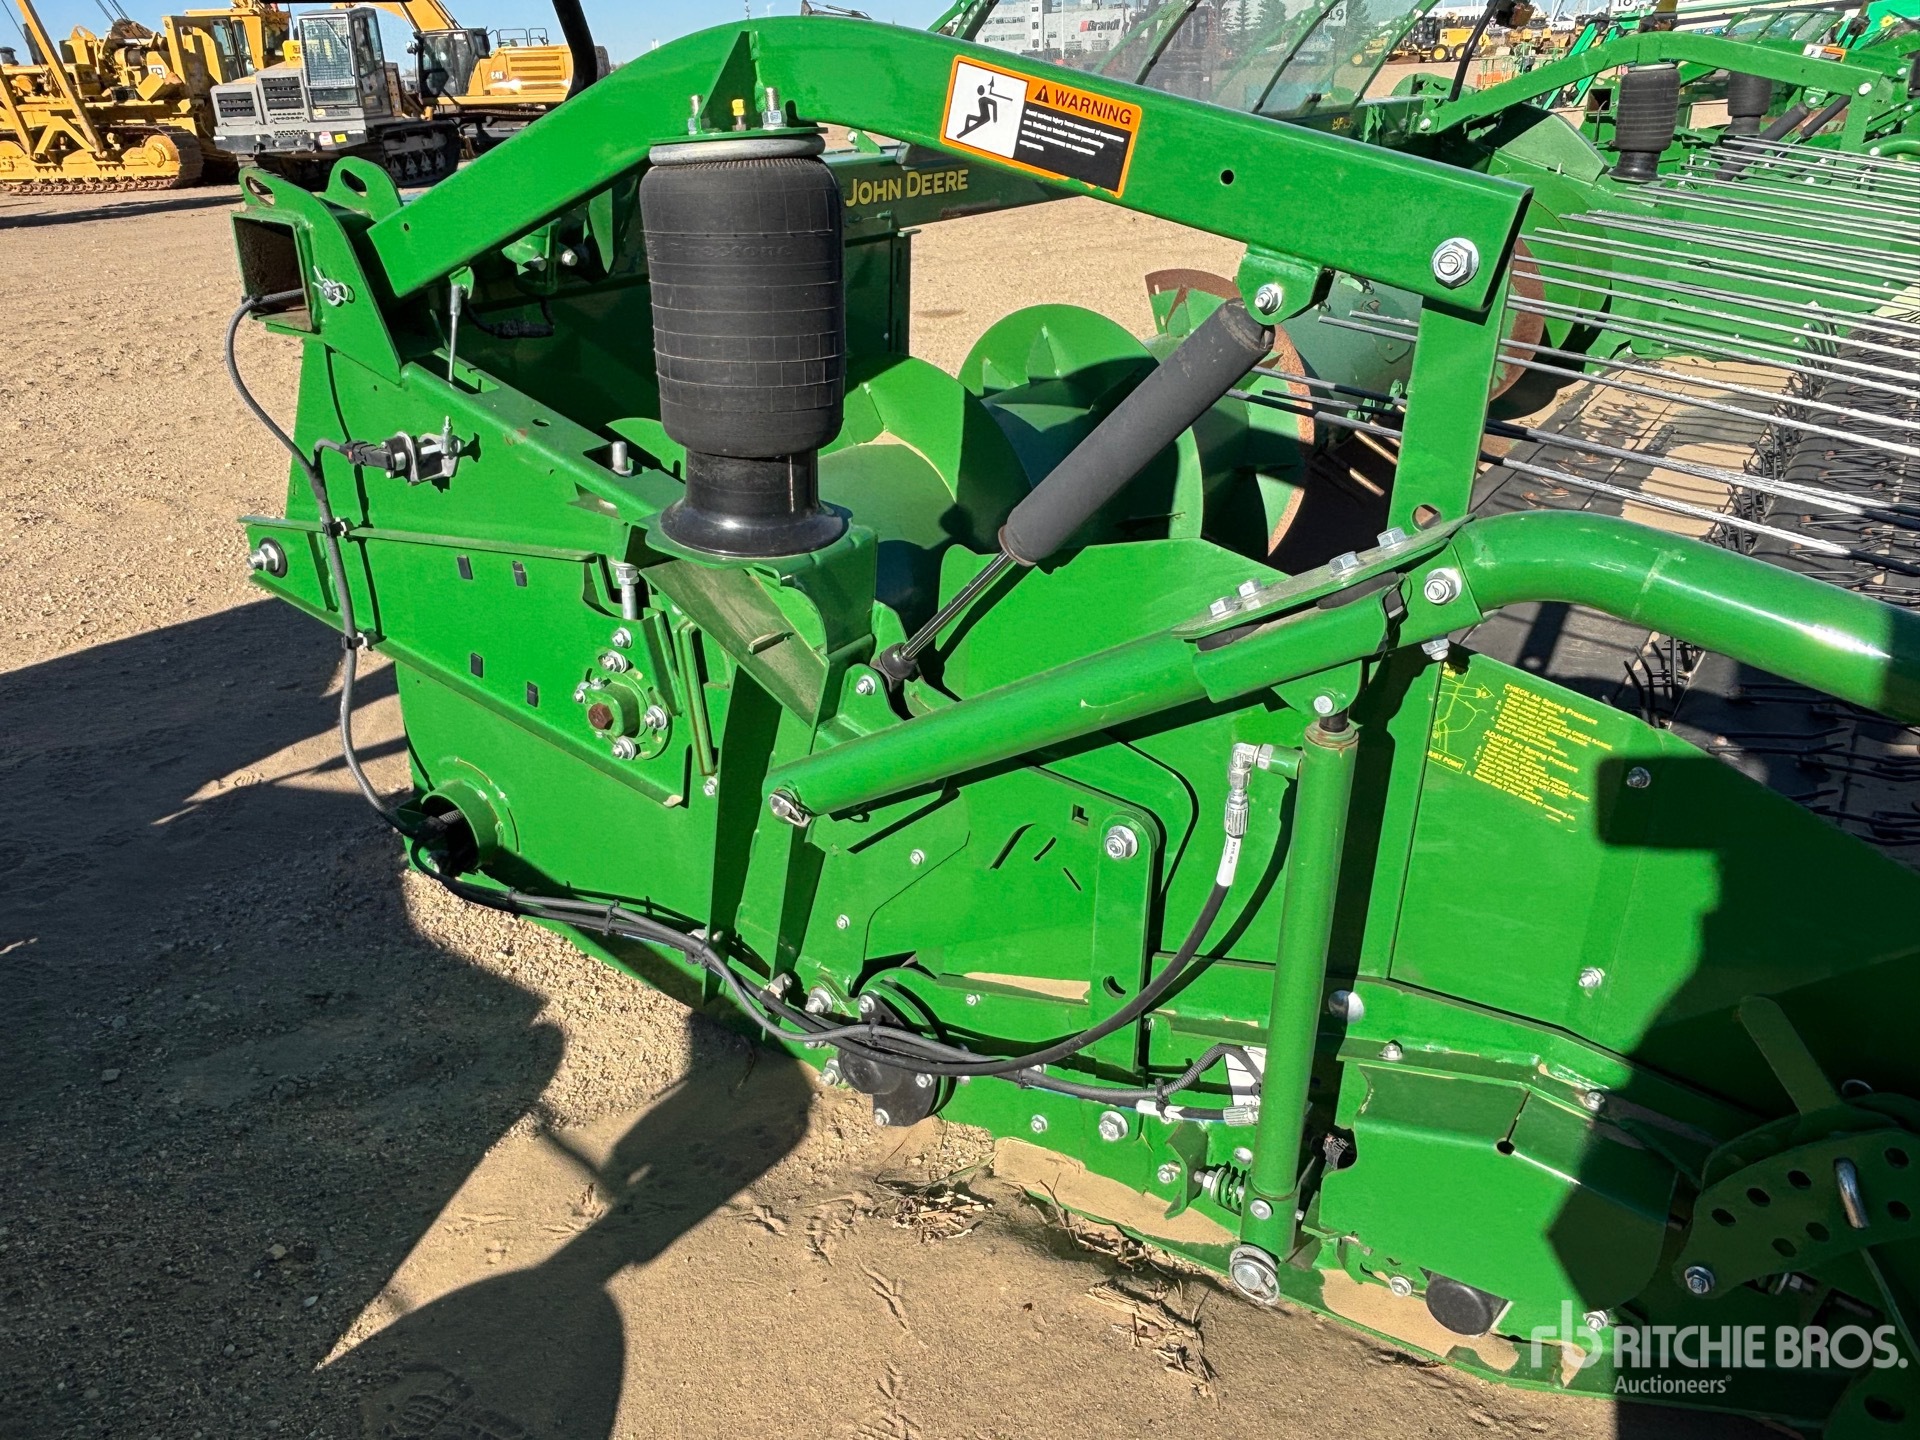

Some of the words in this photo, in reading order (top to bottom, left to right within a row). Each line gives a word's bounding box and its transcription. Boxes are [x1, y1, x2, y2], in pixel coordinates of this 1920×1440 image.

[1087, 19, 1120, 31] Brandt
[1055, 90, 1132, 124] WARNING
[846, 178, 901, 207] JOHN
[906, 169, 969, 198] DEERE
[1503, 682, 1530, 698] CHECK
[1530, 693, 1542, 702] Air
[1540, 697, 1566, 713] Spring
[1565, 707, 1598, 725] Pressure
[1442, 756, 1463, 769] POINT
[1484, 728, 1512, 745] ADJUST
[1512, 740, 1524, 750] Air
[1523, 745, 1547, 761] Spring
[1546, 755, 1579, 773] Pressure
